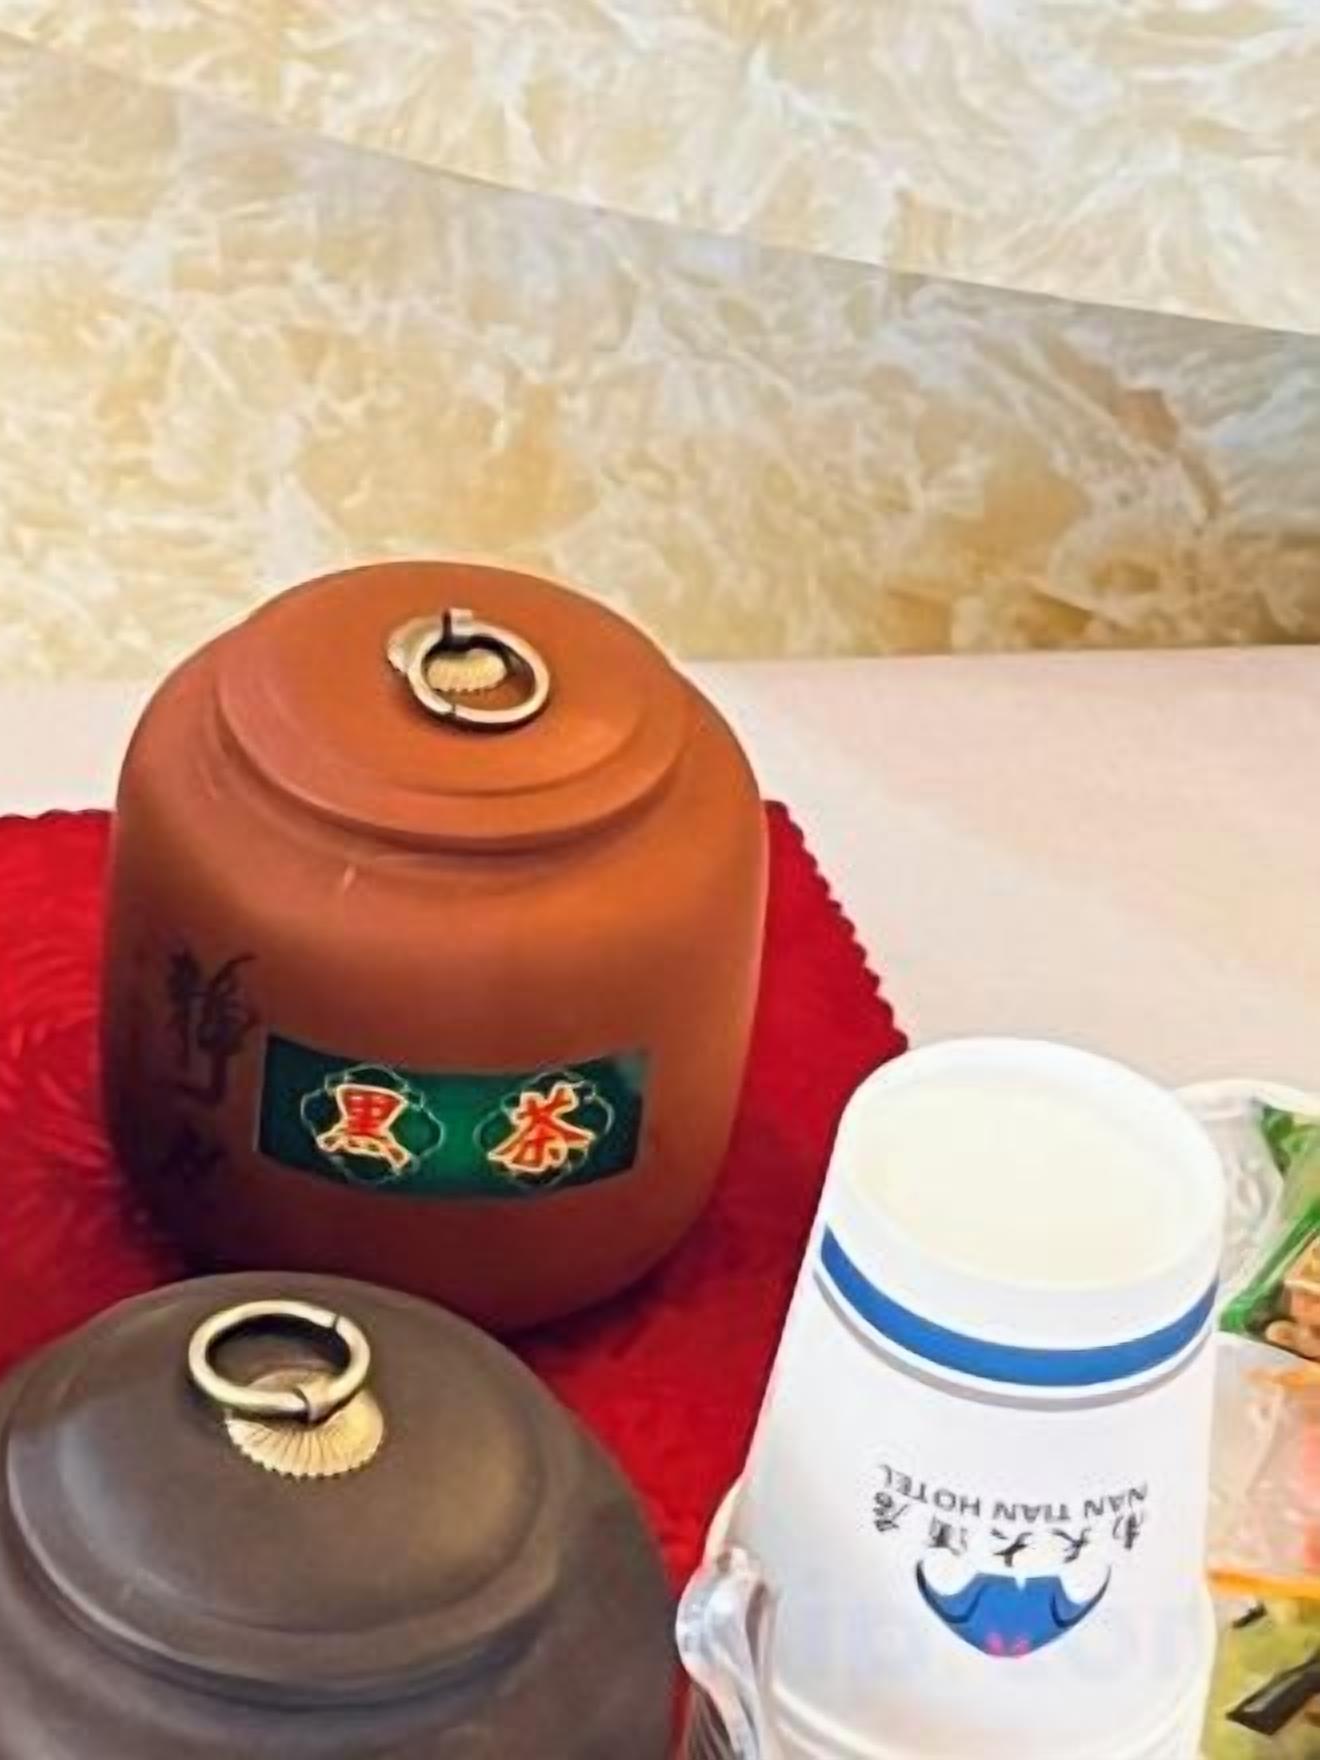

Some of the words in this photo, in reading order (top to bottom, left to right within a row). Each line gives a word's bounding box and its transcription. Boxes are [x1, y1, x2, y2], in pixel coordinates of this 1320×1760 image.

[316, 1082, 596, 1174] 黑茶
[879, 1464, 981, 1518] HOTEL
[993, 1502, 1071, 1524] TIAN
[1083, 1482, 1148, 1519] NAN
